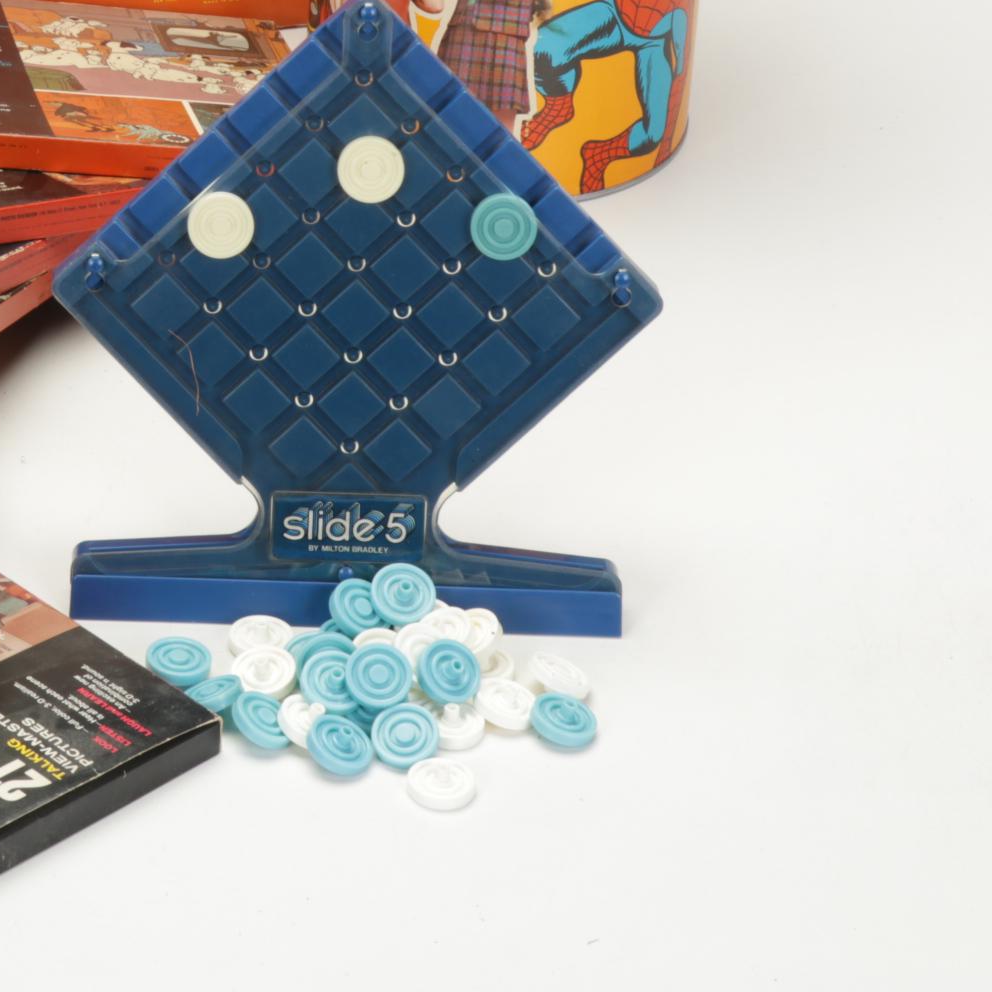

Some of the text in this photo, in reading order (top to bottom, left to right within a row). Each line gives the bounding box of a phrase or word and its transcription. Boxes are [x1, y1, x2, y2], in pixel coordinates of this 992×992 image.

[283, 504, 411, 543] slide 5
[322, 545, 350, 553] MILTON
[352, 545, 389, 554] BRADLEY
[77, 687, 108, 708] LEARN
[100, 724, 132, 747] LISTEN
[120, 714, 152, 737] LAUGH
[21, 717, 94, 767] PICTURES
[93, 735, 118, 753] LOOK
[7, 737, 66, 781] TALKING
